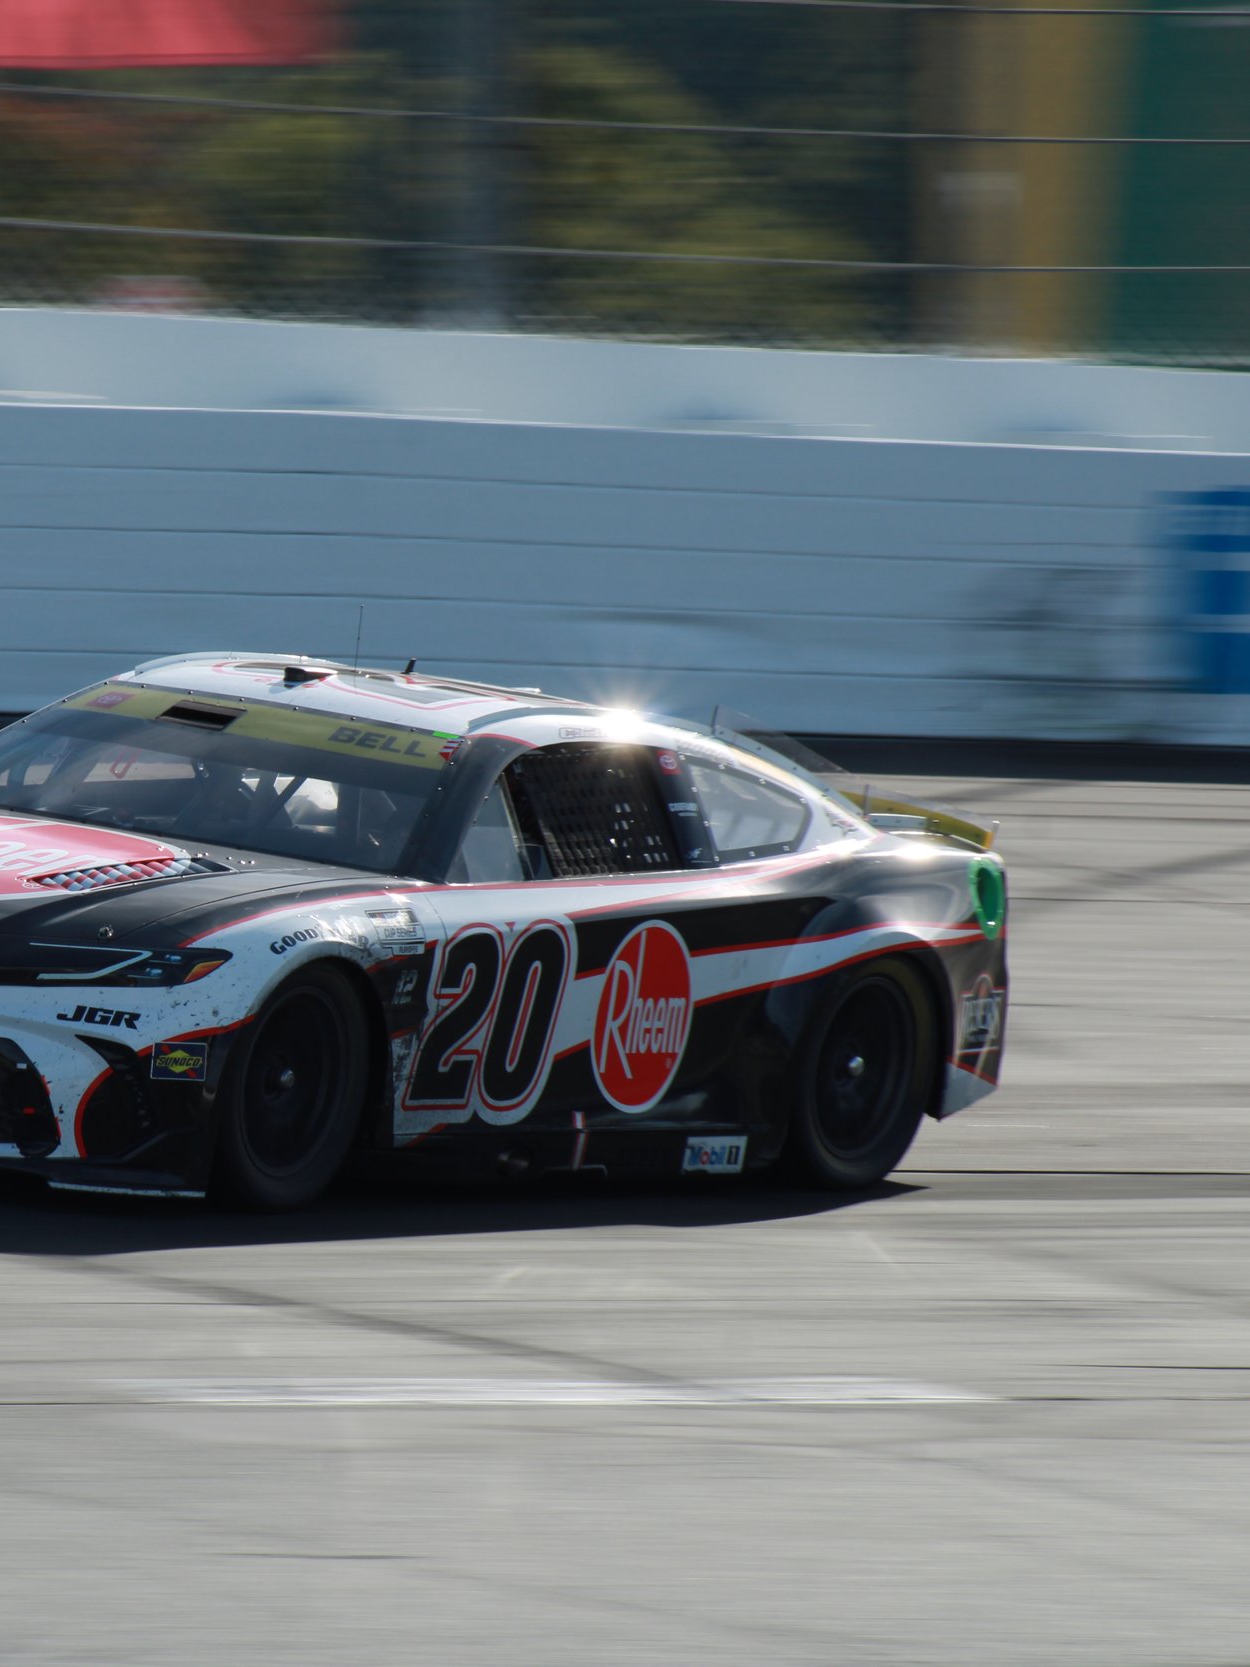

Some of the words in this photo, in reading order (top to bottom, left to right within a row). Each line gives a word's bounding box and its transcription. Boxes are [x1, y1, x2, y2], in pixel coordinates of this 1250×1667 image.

[328, 726, 426, 758] BELL
[56, 1004, 141, 1030] JGR
[404, 921, 568, 1109] 20
[599, 931, 687, 1079] Rheem
[157, 1055, 203, 1068] SUNOCO
[687, 1143, 726, 1165] Mobil
